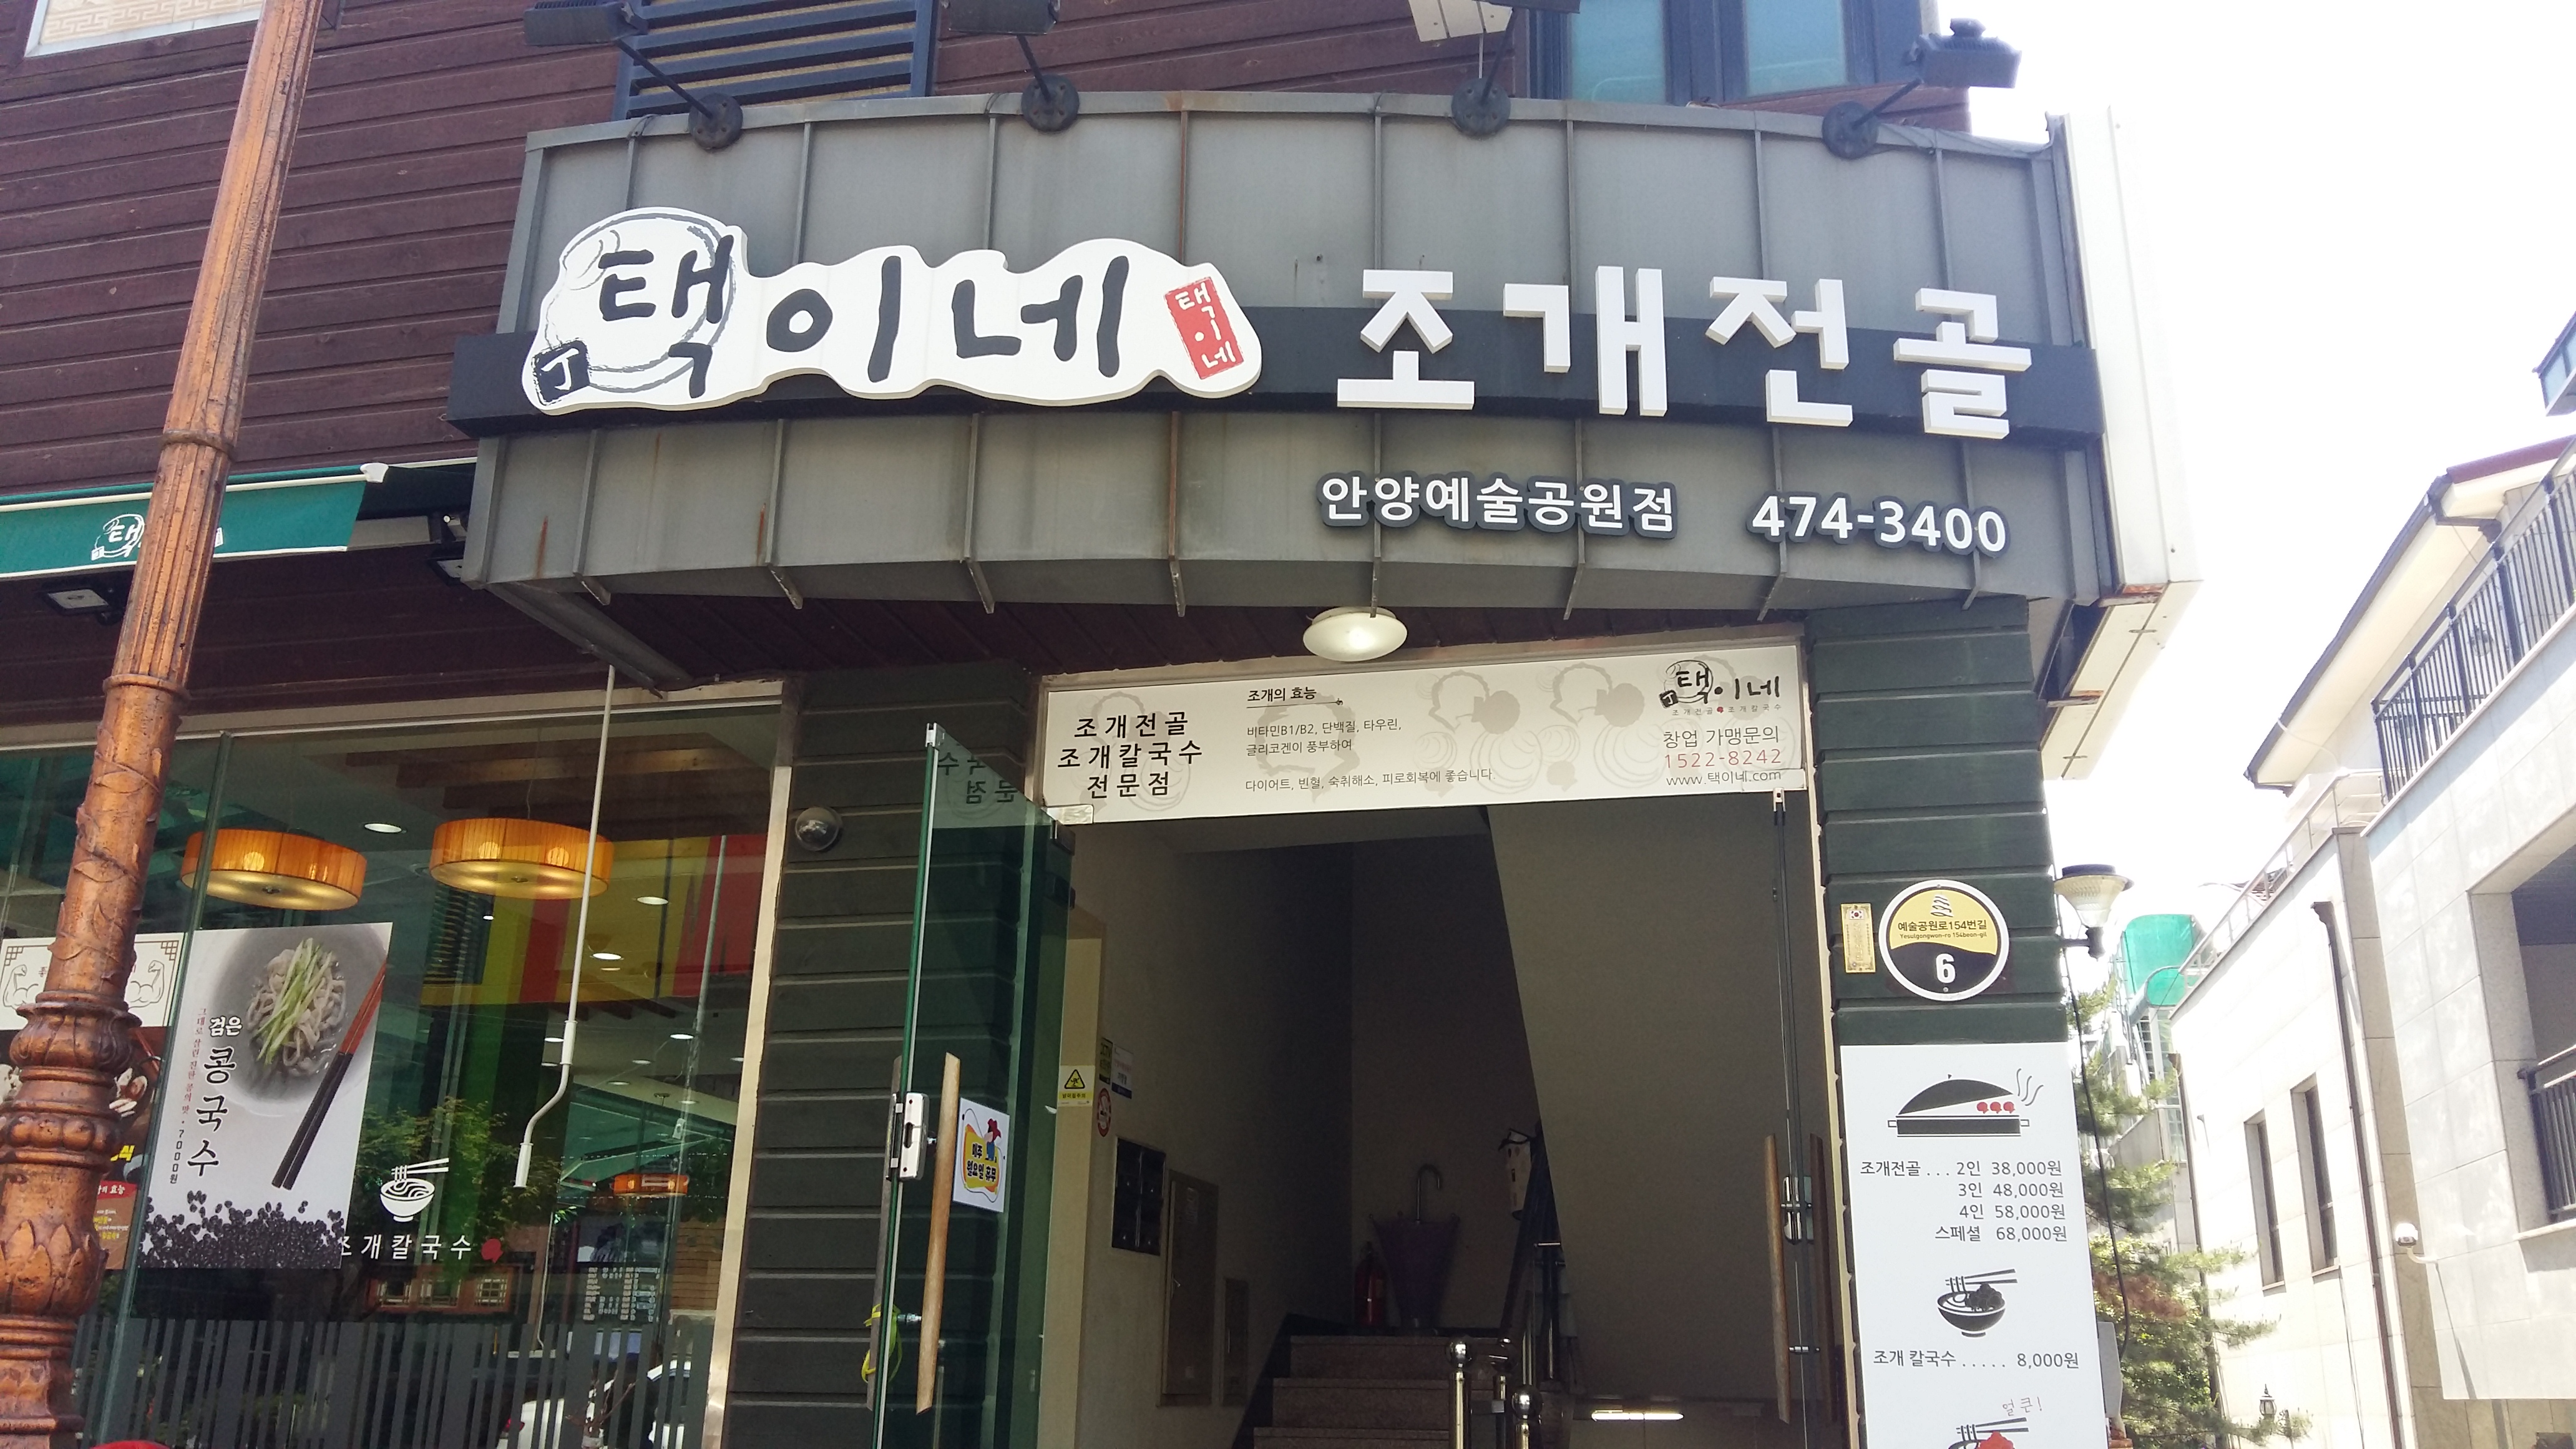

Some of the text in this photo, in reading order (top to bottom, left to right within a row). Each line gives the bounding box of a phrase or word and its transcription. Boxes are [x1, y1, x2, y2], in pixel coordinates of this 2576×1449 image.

[597, 233, 1129, 399] 택이네
[1337, 266, 2033, 439] 조개전골
[1322, 476, 1674, 533] 안양예술공원점
[1752, 495, 2006, 554] 474-3400
[1247, 686, 1317, 702] 조개의 효능
[1676, 667, 1780, 704] 택이네
[1672, 703, 1782, 716] 조개전골 조개칼국수
[1074, 712, 1189, 739] 조개전골
[1247, 717, 1402, 738] 비타민B1/B2, 단백질, 타우린,
[1247, 739, 1352, 756] 글리코겐이 풍부하여
[1663, 725, 1779, 749] 창업 가맹문의
[1057, 739, 1203, 769] 조개칼국수
[1664, 748, 1782, 769] 1522-8242
[1087, 771, 1170, 799] 전문점
[1246, 768, 1496, 792] 다이어트, 빈혈, 숙취해소, 피로회복에 좋습니다.
[1666, 771, 1782, 786] www.택이네.com
[1898, 919, 1988, 932] 예술공원로154번길
[1936, 953, 1956, 983] 6
[209, 1015, 243, 1037] 검은
[187, 1045, 236, 1177] 콩국수
[985, 1165, 997, 1182] 휴무
[1860, 1160, 2062, 1178] 조개전골 2인 38,000원
[1958, 1181, 2064, 1199] 3인 48,000원
[1959, 1203, 2066, 1221] 4인 58,000원
[1934, 1225, 2067, 1242] 스페셜 68,000원
[1873, 1350, 2079, 1369] 조개 칼국수 8,000원
